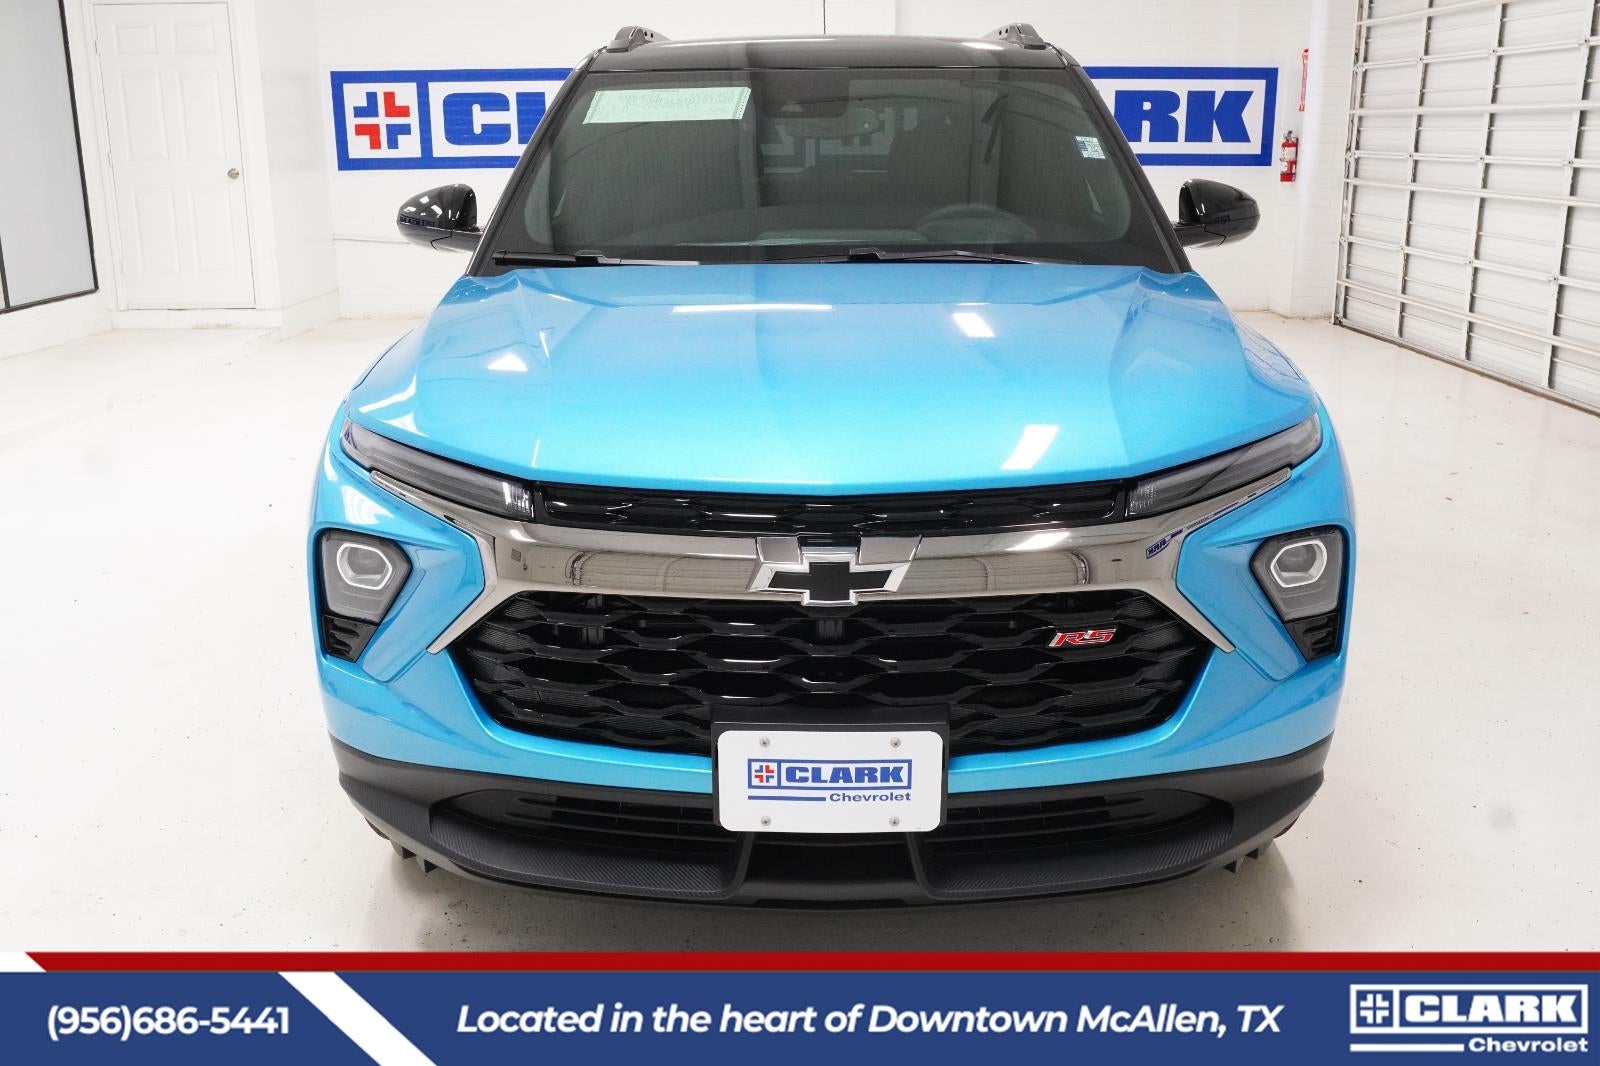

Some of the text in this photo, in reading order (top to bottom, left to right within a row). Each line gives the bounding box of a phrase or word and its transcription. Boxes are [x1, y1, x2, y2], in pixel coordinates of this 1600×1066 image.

[1048, 627, 1117, 648] RS
[785, 766, 904, 783] CLARK
[829, 792, 912, 802] Chevrolet
